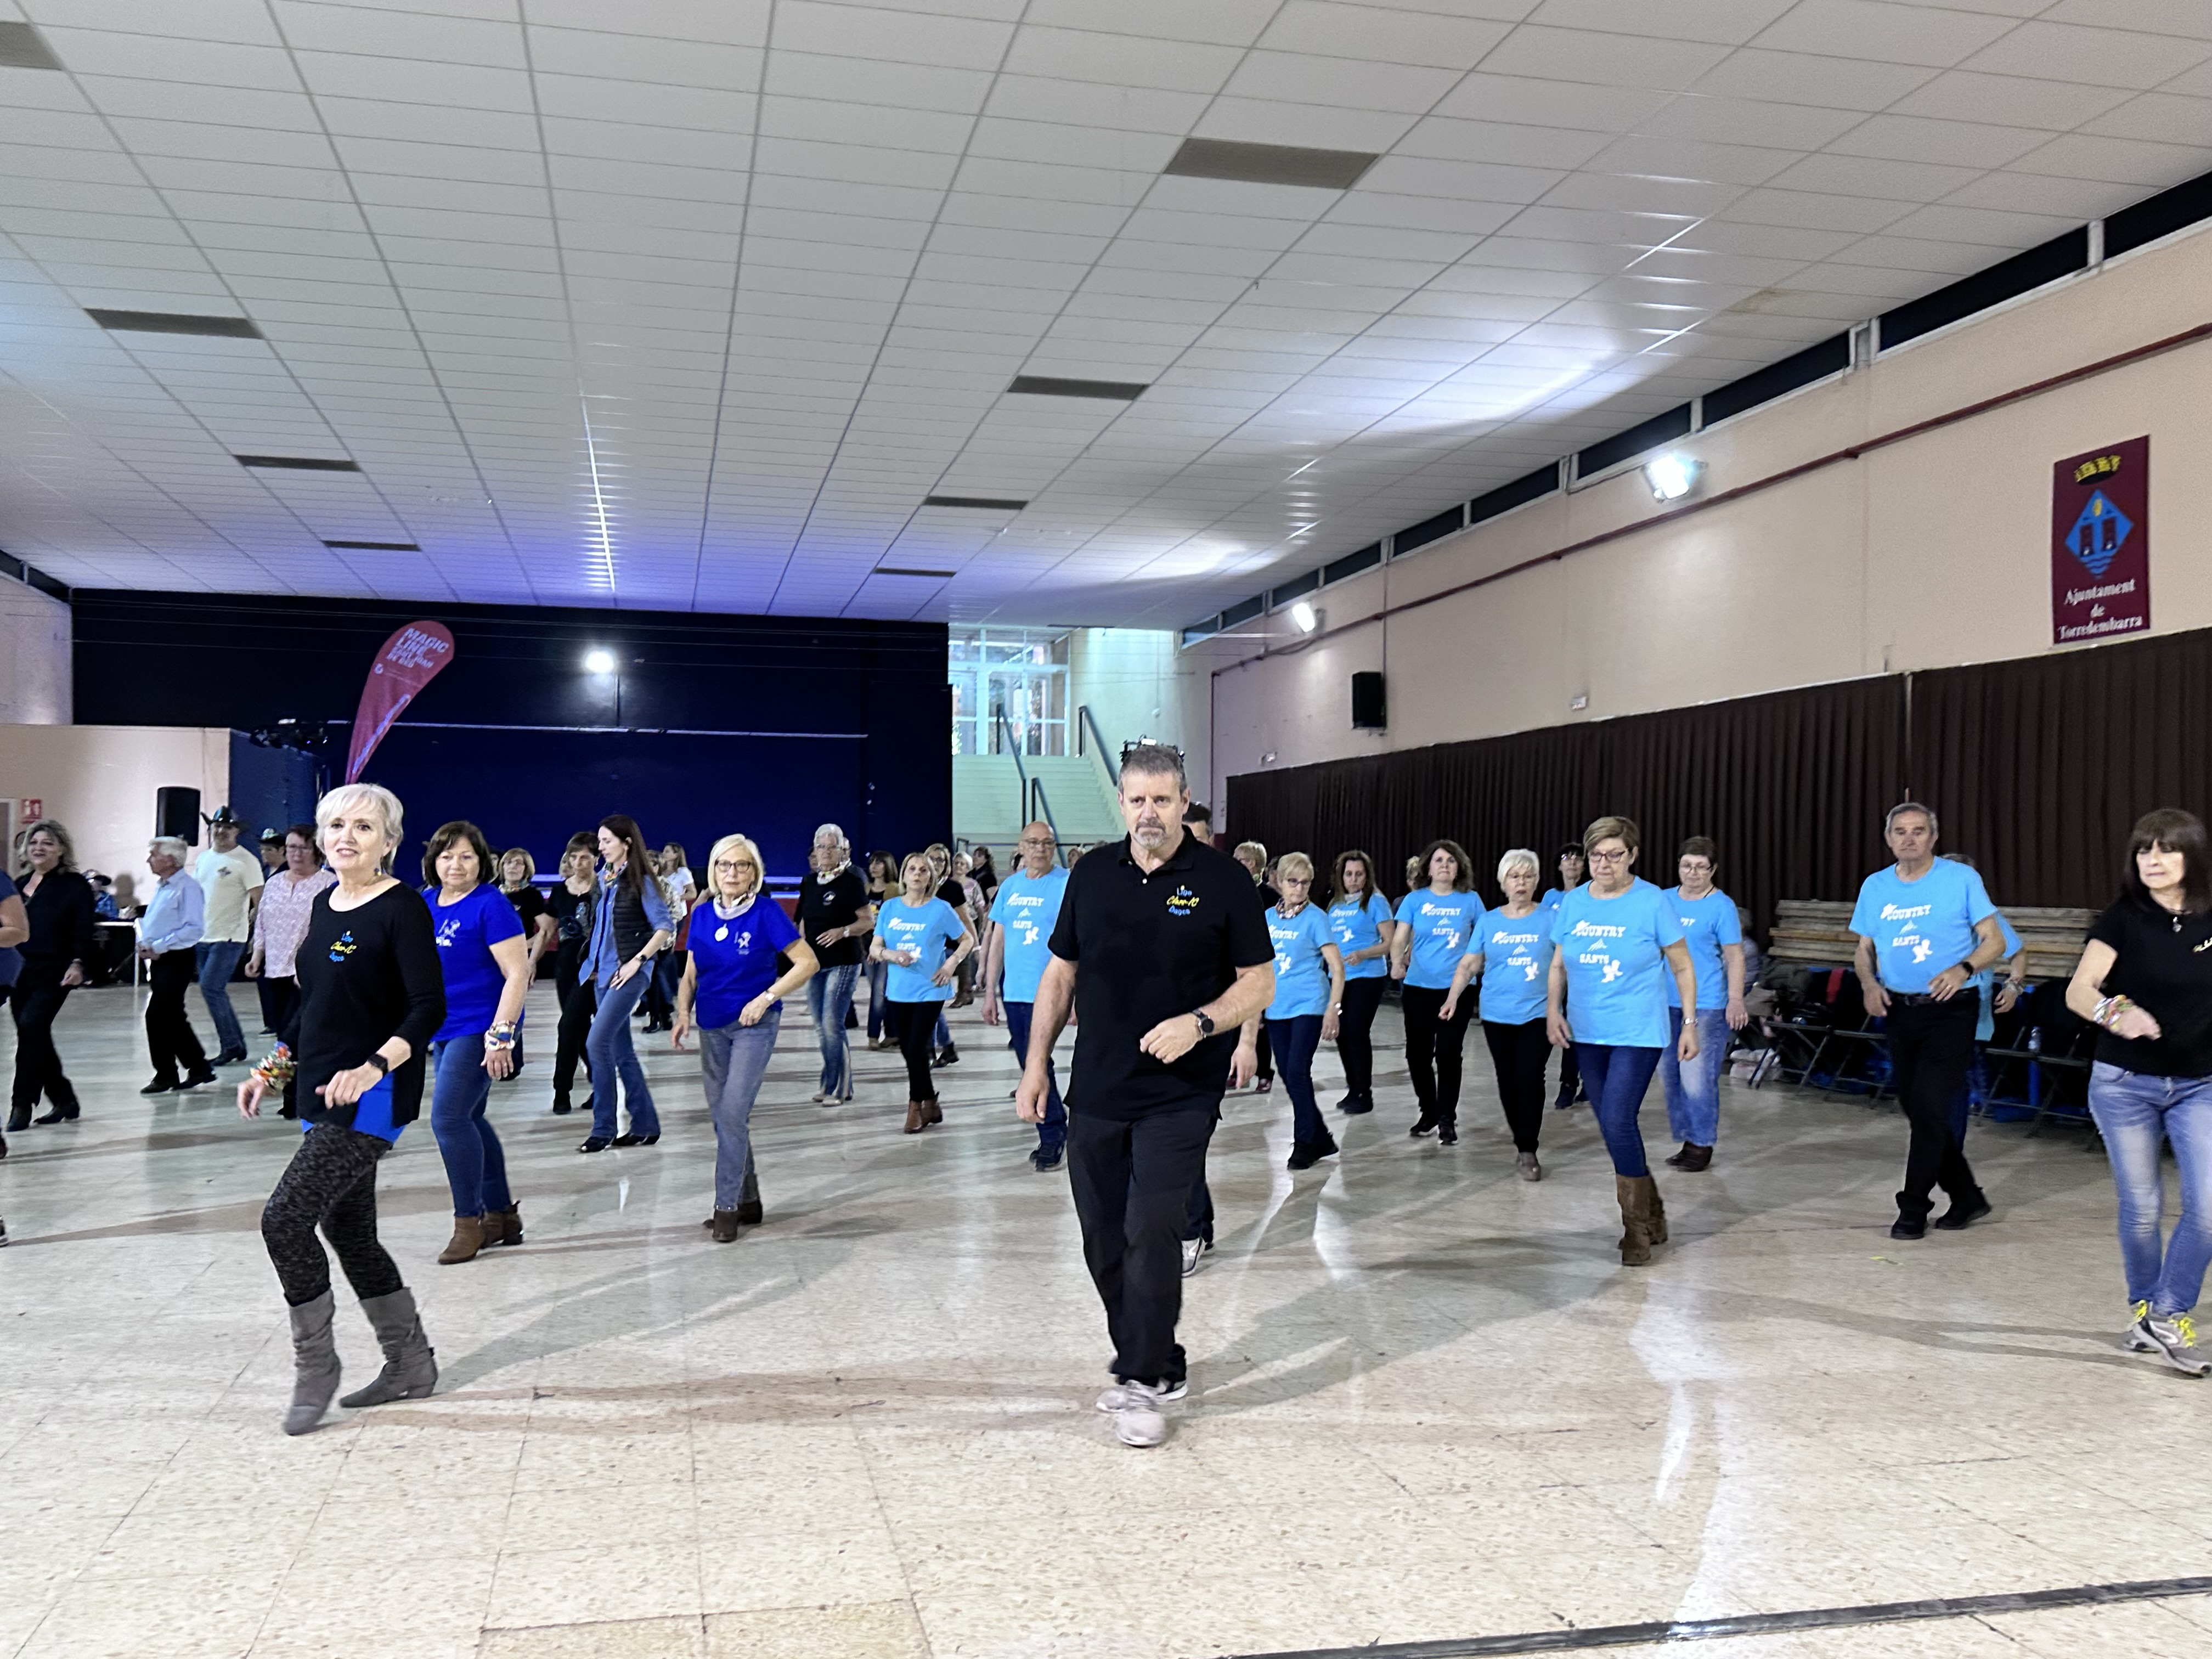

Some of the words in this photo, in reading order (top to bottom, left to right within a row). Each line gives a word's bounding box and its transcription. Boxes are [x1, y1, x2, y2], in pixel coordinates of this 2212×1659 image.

[2064, 579, 2135, 606] Ajuntament
[2090, 603, 2105, 618] de
[2058, 616, 2142, 639] Torredembarra
[403, 627, 449, 653] MAGIC
[1575, 923, 1627, 938] COUNTRY
